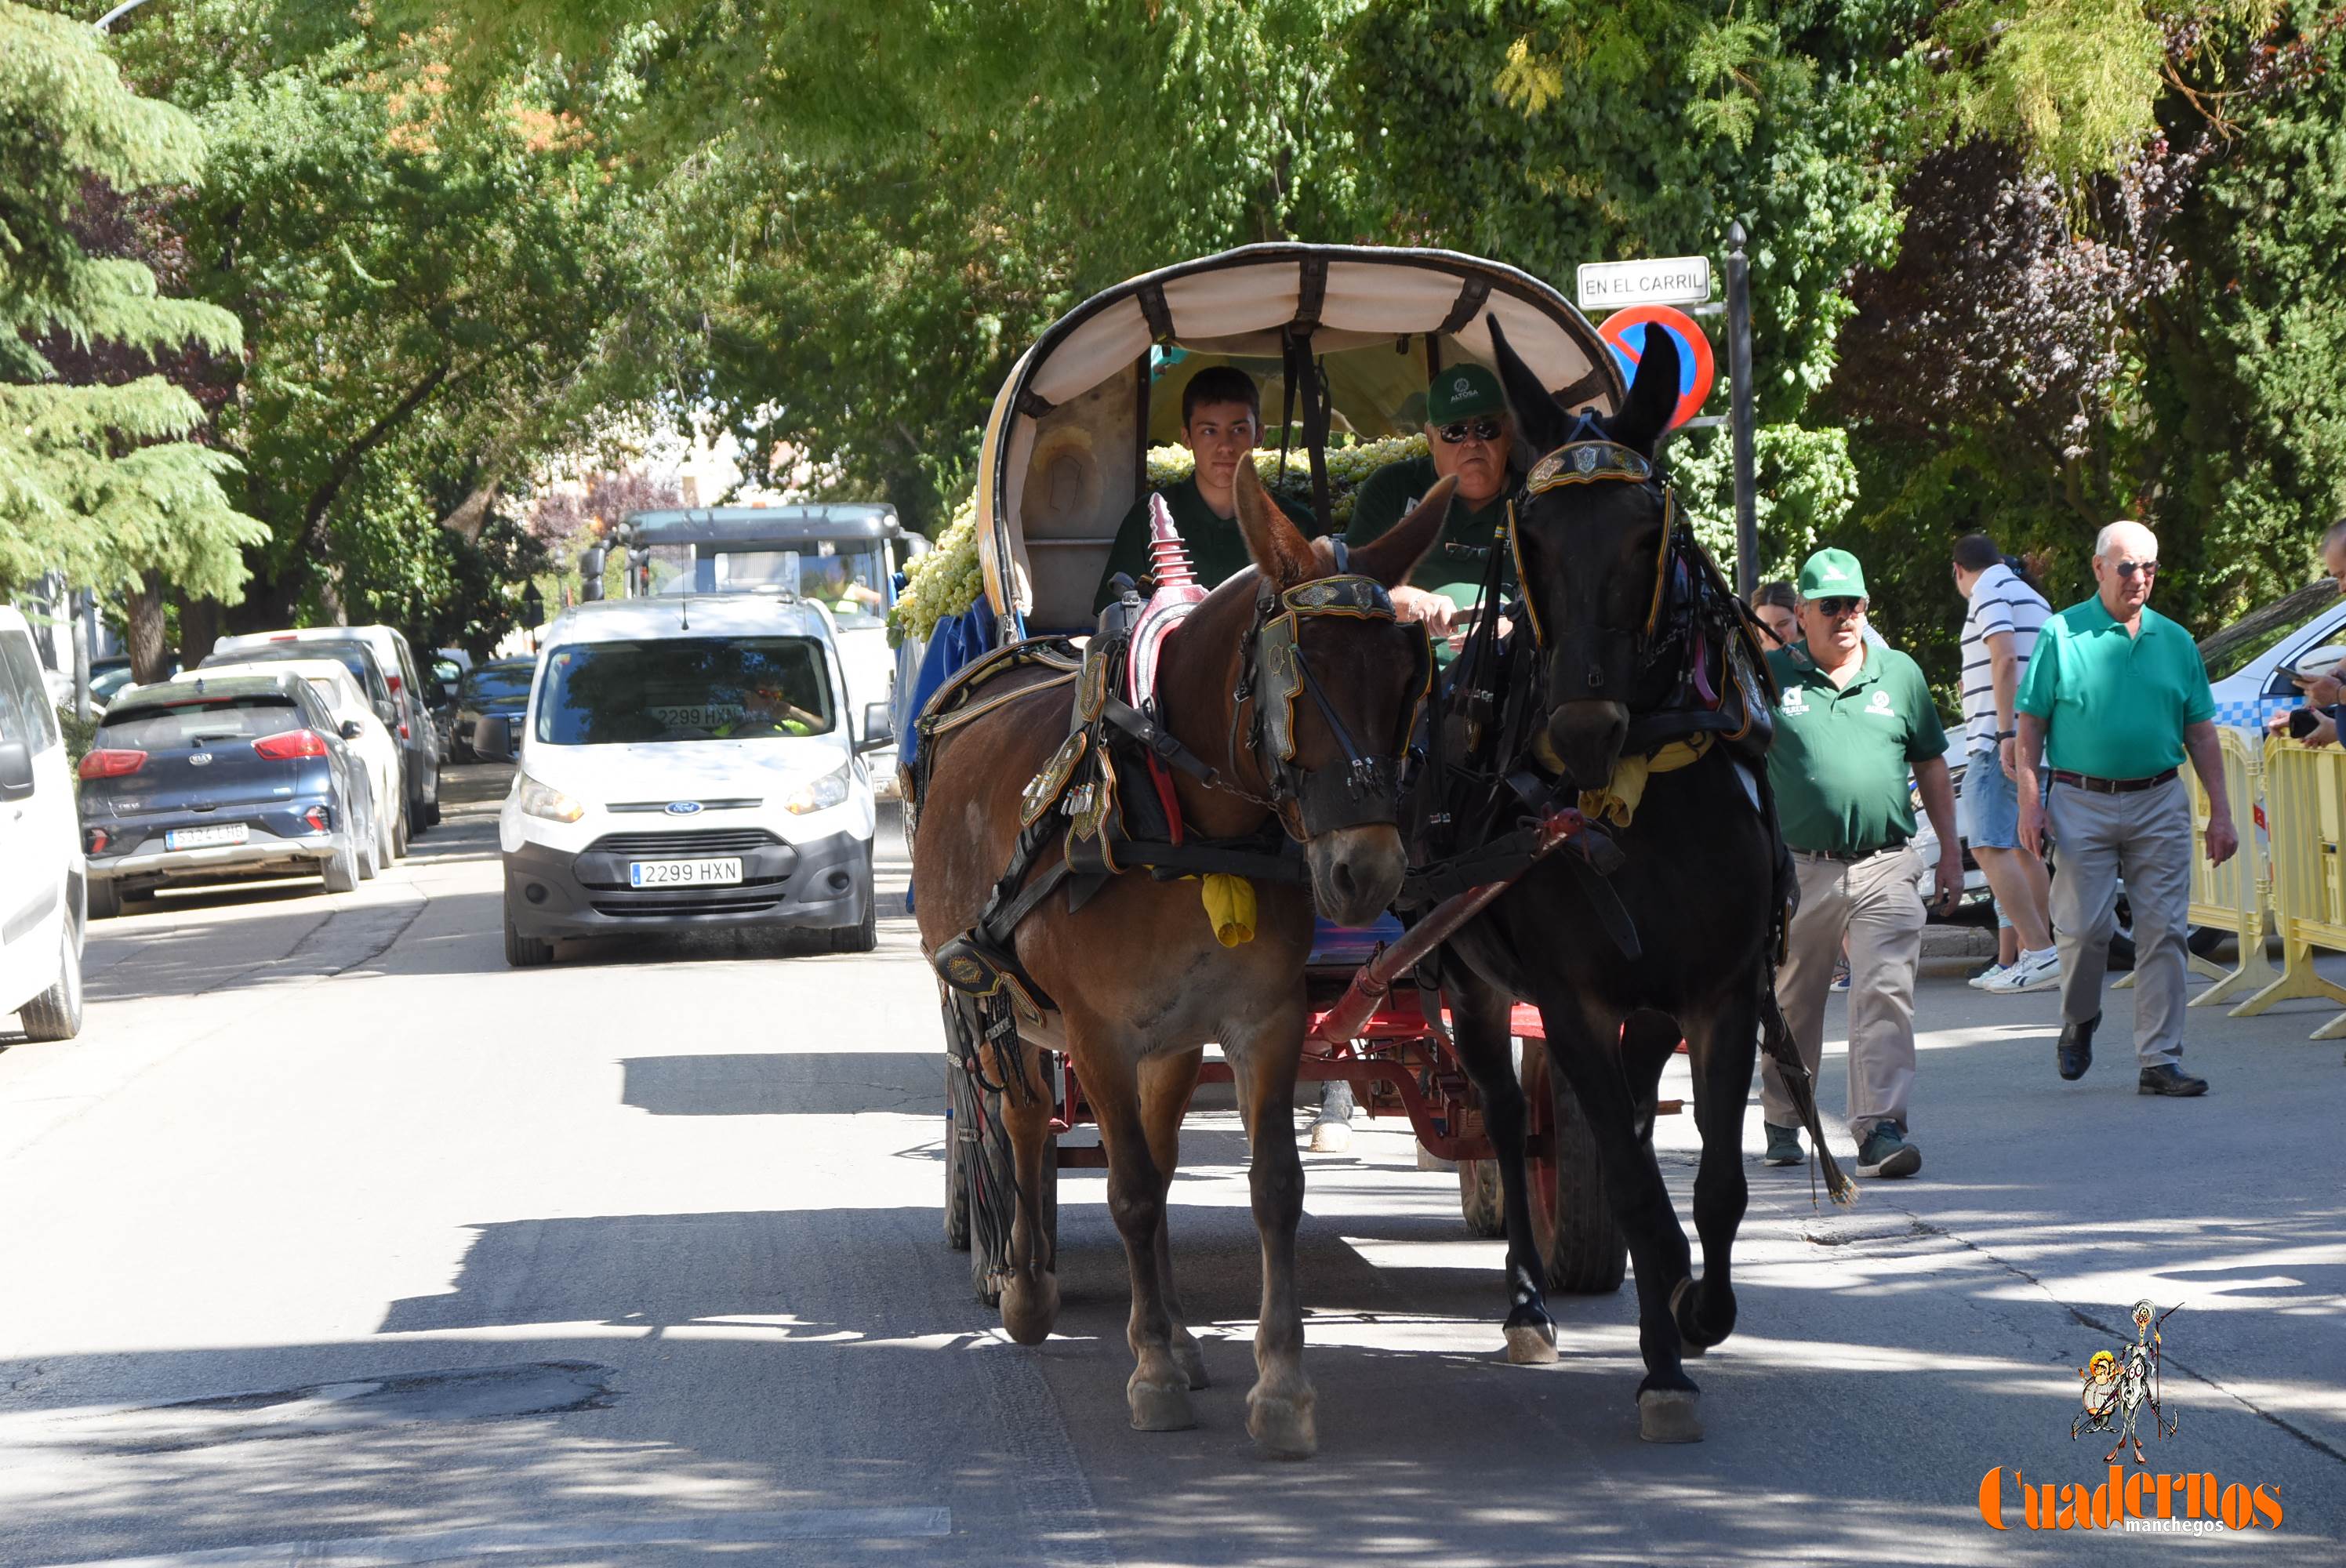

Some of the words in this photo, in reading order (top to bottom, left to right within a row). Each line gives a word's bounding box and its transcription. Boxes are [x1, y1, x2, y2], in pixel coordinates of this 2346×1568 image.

[1585, 280, 1607, 295] EN
[1614, 278, 1634, 293] EL
[1640, 273, 1703, 292] CARRIL
[1451, 390, 1479, 402] ALTOSA
[657, 709, 700, 725] 2299
[645, 864, 693, 883] 2299
[700, 862, 736, 880] HXN
